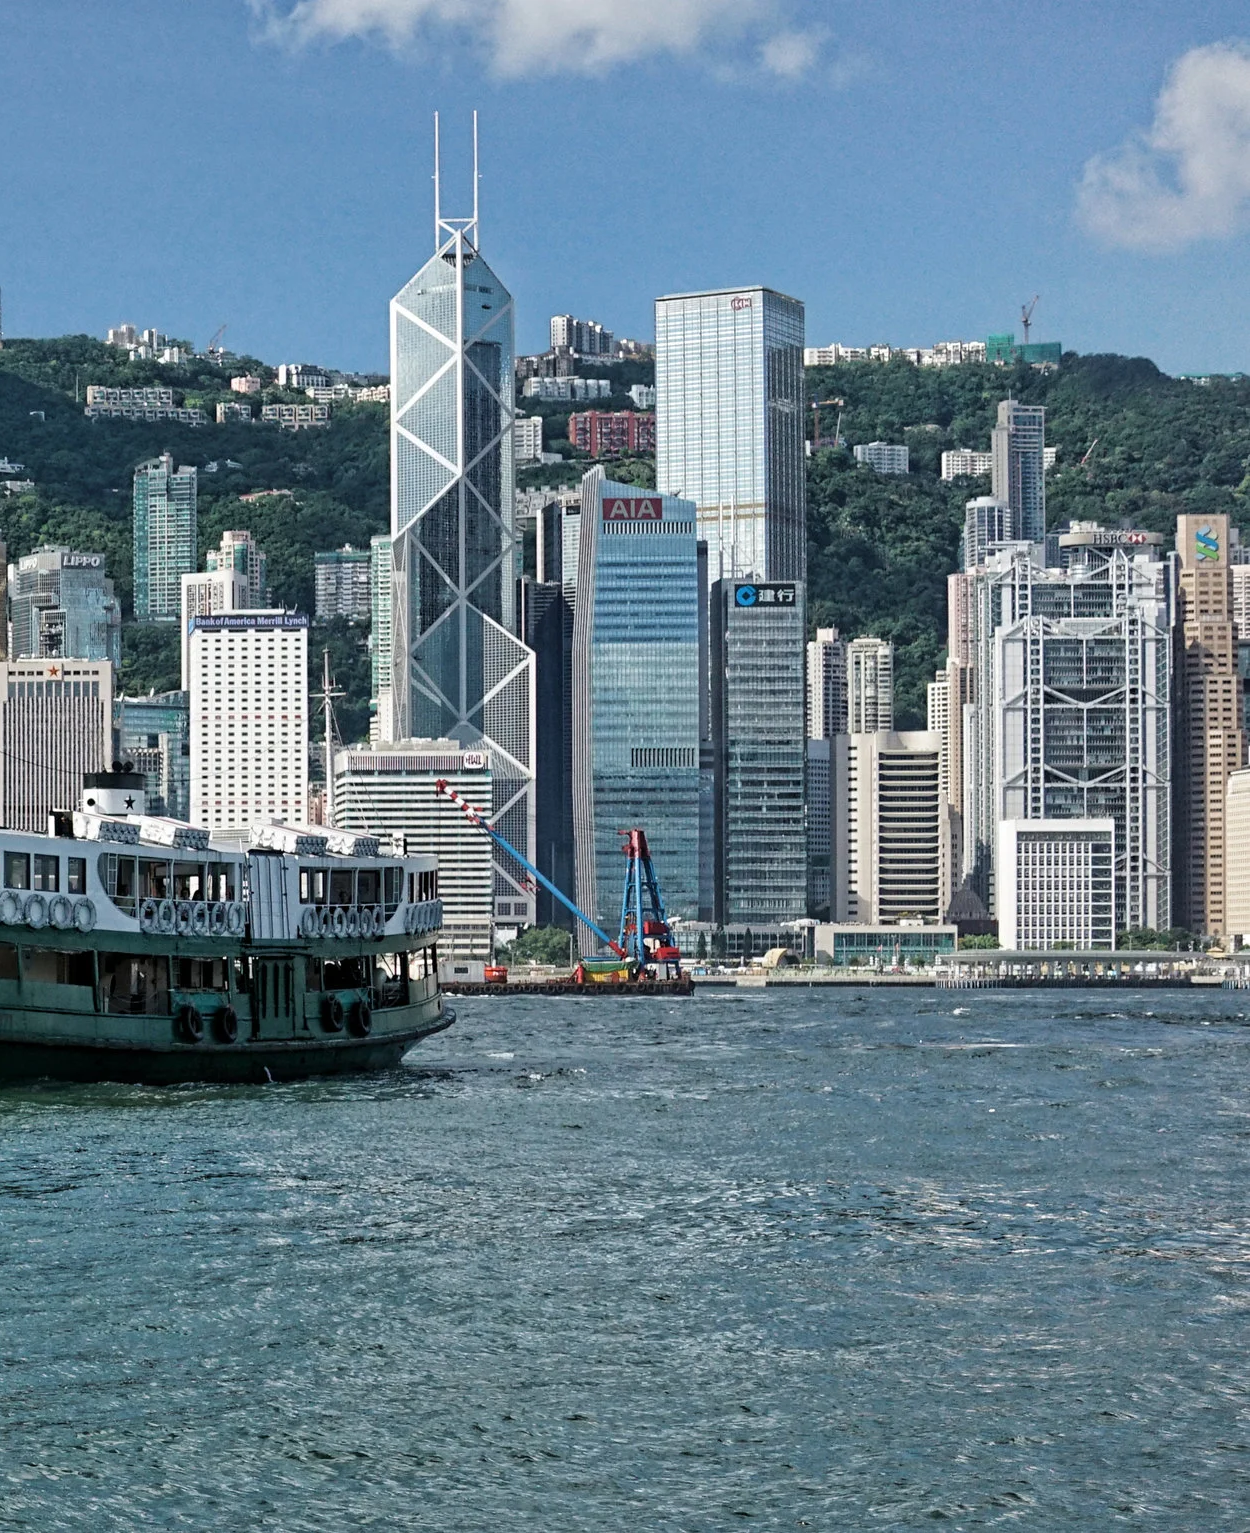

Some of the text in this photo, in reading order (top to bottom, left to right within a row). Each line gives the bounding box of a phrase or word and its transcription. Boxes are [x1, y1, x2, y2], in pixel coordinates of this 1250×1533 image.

[610, 499, 656, 518] AIA
[1093, 534, 1127, 545] HSBC
[63, 555, 100, 567] LIPPO
[758, 589, 794, 602] 建行
[196, 616, 307, 626] Bank of America Merrill Lynch
